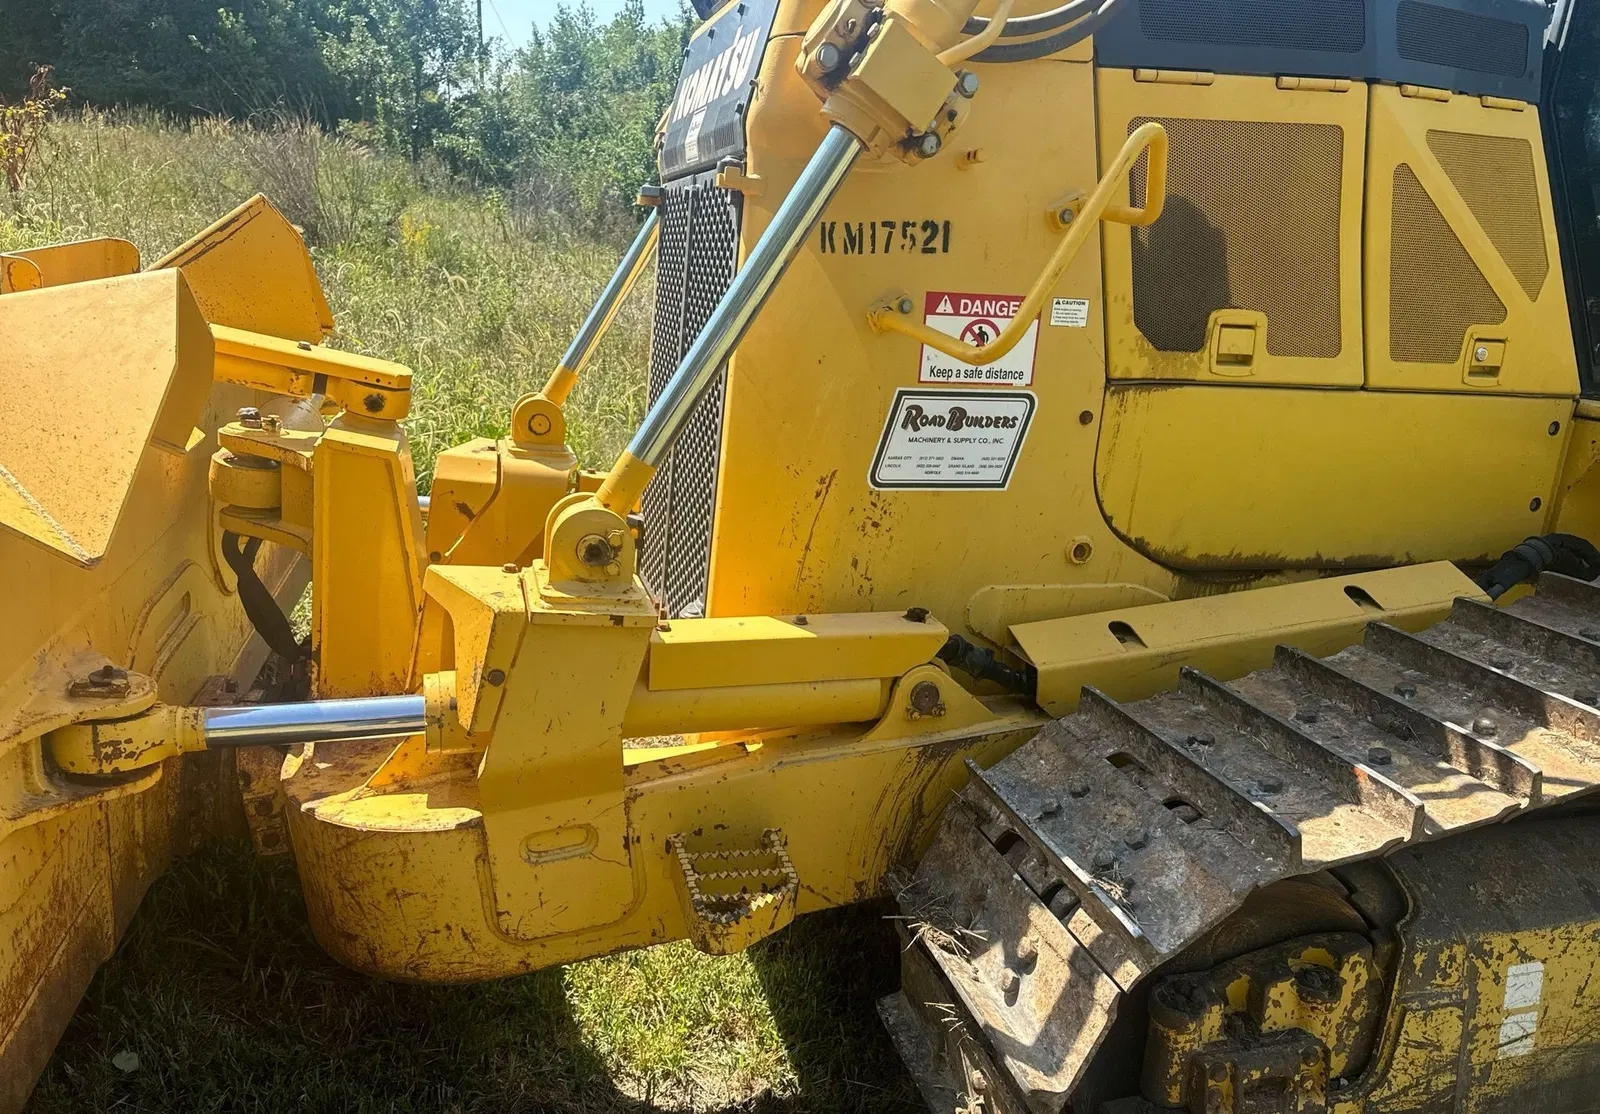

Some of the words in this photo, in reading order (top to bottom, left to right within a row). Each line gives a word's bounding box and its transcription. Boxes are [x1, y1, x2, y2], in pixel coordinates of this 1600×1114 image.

[672, 25, 761, 123] KOMATSU
[820, 220, 951, 254] KM17521
[959, 299, 1022, 316] DANGE
[929, 365, 953, 380] Keep
[955, 369, 961, 378] a
[963, 367, 983, 379] safe
[985, 367, 1024, 380] distance
[901, 404, 946, 432] ROAD
[946, 406, 1019, 431] BUILDERS
